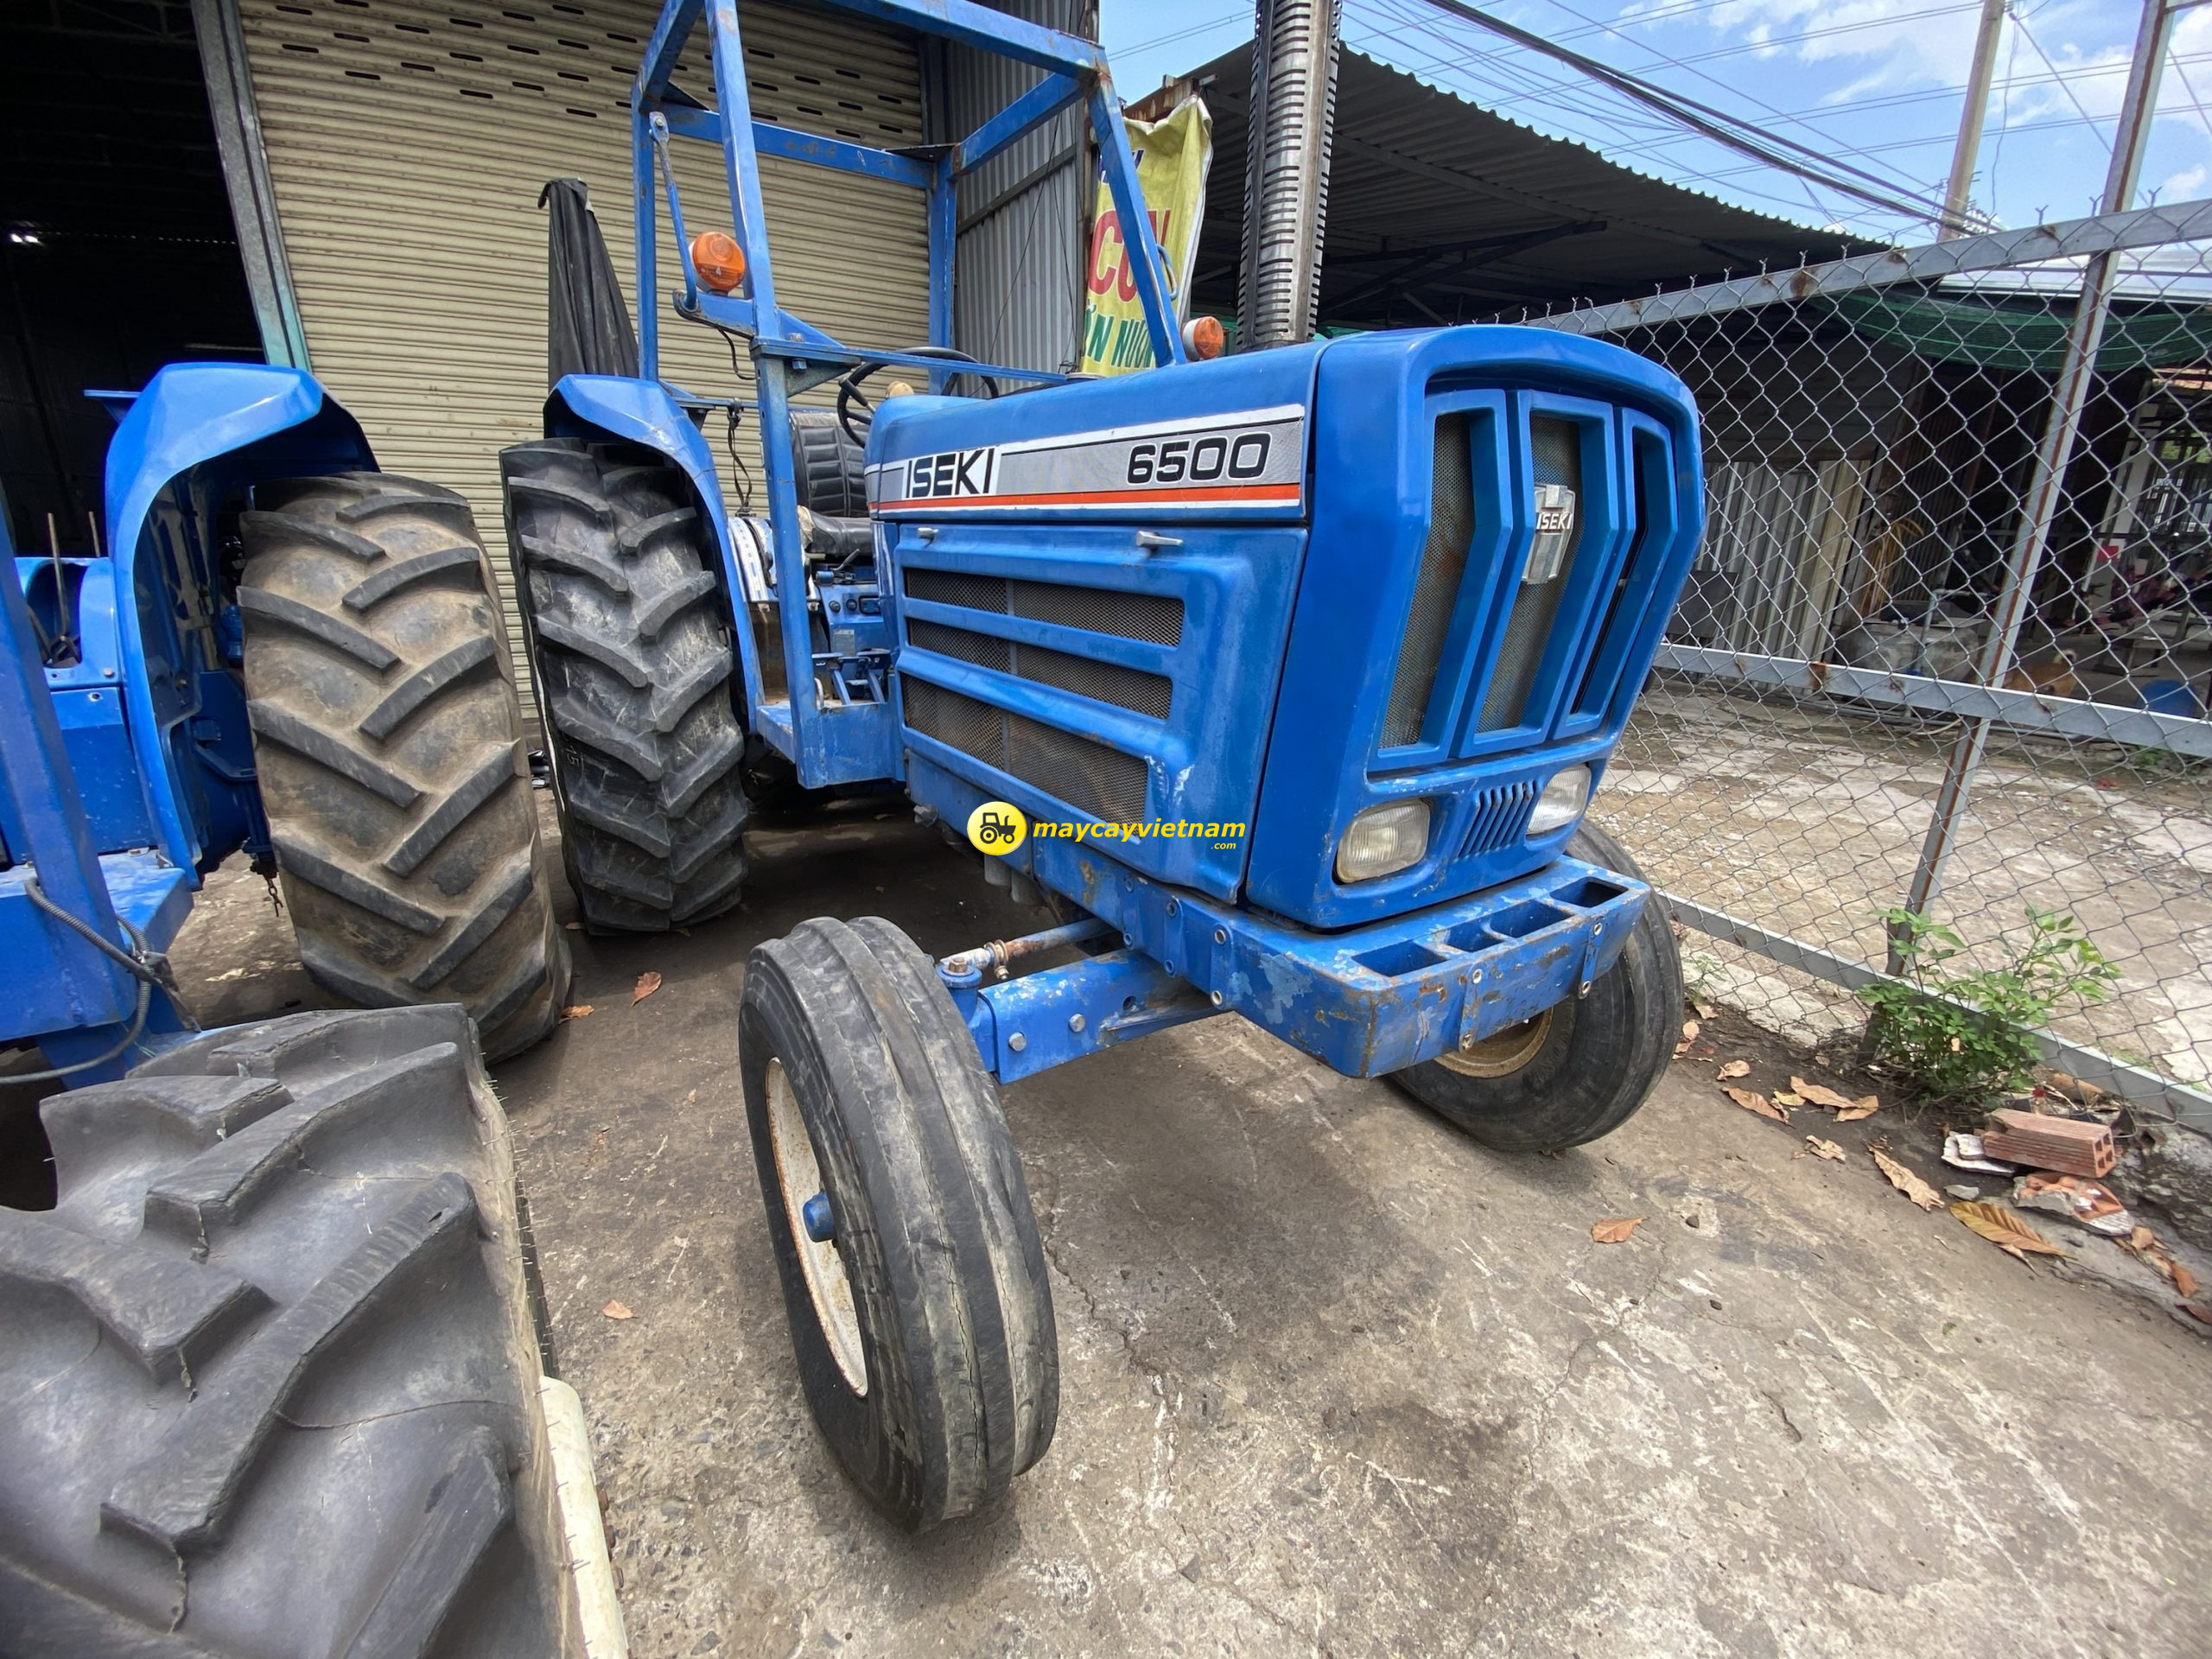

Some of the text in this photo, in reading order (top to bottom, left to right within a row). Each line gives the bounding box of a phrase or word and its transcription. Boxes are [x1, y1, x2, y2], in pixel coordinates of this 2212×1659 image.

[906, 432, 1272, 499] ISEKI 6500
[1536, 512, 1573, 530] ISEKI
